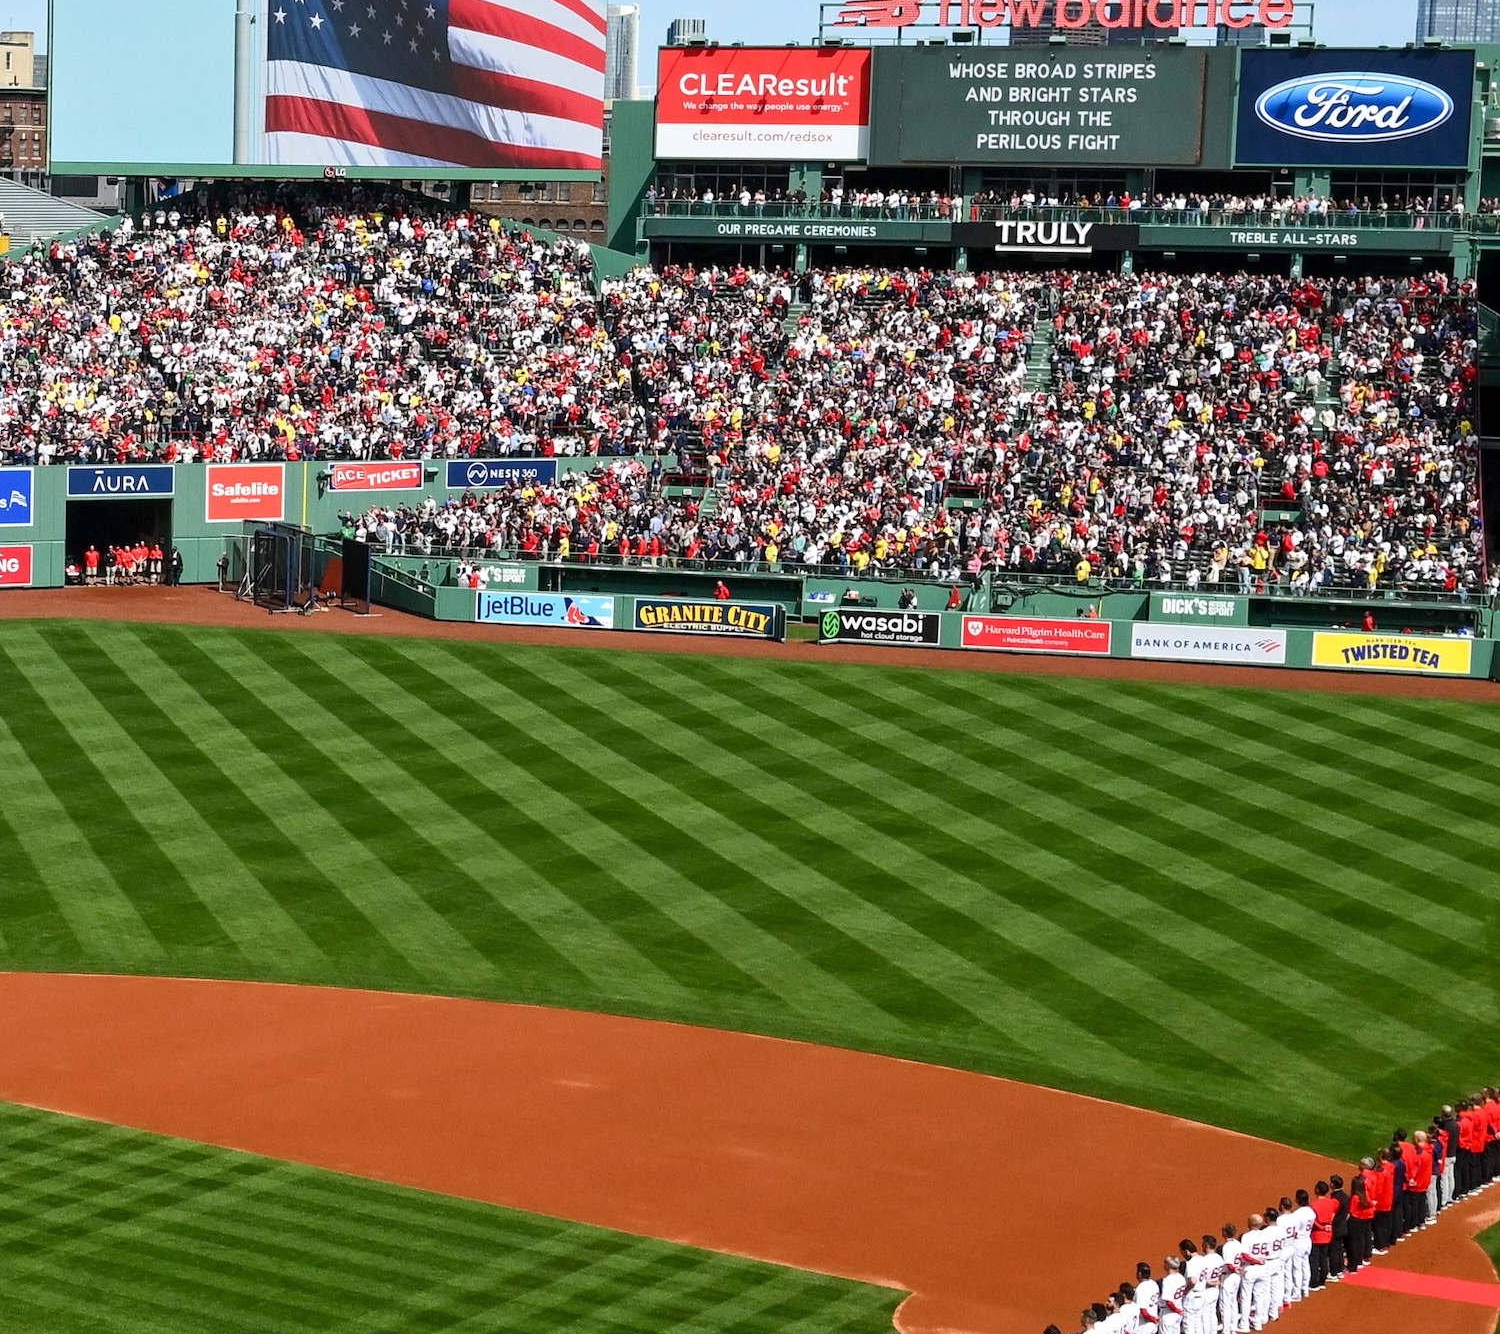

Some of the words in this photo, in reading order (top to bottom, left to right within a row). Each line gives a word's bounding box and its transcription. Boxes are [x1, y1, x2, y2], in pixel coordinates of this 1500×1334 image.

[949, 63, 1008, 79] WHOSE
[1014, 63, 1077, 79] BROAD
[1083, 64, 1156, 79] STRIPES
[678, 73, 847, 98] CLEAResult
[965, 87, 1003, 103] AND
[1009, 87, 1073, 103] BRIGHT
[1078, 87, 1137, 103] STARS
[682, 101, 696, 111] We
[699, 101, 728, 114] change
[731, 101, 743, 111] the
[746, 103, 763, 114] way
[765, 102, 794, 115] people
[796, 104, 811, 112] use
[1294, 83, 1411, 131] Ford
[988, 110, 1072, 127] THROUGH
[1077, 111, 1112, 127] THE
[692, 128, 833, 143] clearesult.com/redsox
[976, 134, 1062, 150] PERILOUS
[1068, 134, 1120, 150] FIGHT
[336, 168, 346, 176] LG
[717, 223, 742, 236] OUR
[744, 224, 800, 237] PREGAME
[803, 224, 877, 238] CEREMONIES
[994, 220, 1094, 246] TRULY
[1230, 232, 1279, 245] TREBLE
[1282, 233, 1358, 246] ALL-STARS
[336, 469, 365, 483] ACE
[367, 467, 420, 486] TICKET
[490, 468, 520, 479] NESN
[521, 468, 538, 478] 360
[211, 482, 279, 497] Safelite
[503, 575, 526, 583] SPORT
[485, 595, 553, 618] jetBlue
[1162, 598, 1207, 615] DICK'S
[1208, 607, 1235, 616] SPORT
[639, 603, 722, 626] GRANITE
[734, 610, 771, 633] CITY
[841, 613, 924, 634] wasabi
[663, 622, 708, 630] ELECTRIC
[711, 624, 745, 632] SUPPLY
[985, 624, 1020, 636] Harvard
[1021, 626, 1053, 640] Pilgrim
[1054, 628, 1083, 639] Health
[1084, 629, 1105, 640] Care
[861, 631, 873, 639] hot
[874, 632, 894, 640] cloud
[896, 633, 923, 642] storage
[1135, 638, 1170, 648] BANK
[1173, 639, 1191, 649] OF
[1193, 640, 1251, 652] AMERICA
[1341, 643, 1409, 664] TWISTED
[1413, 648, 1440, 668] TEA
